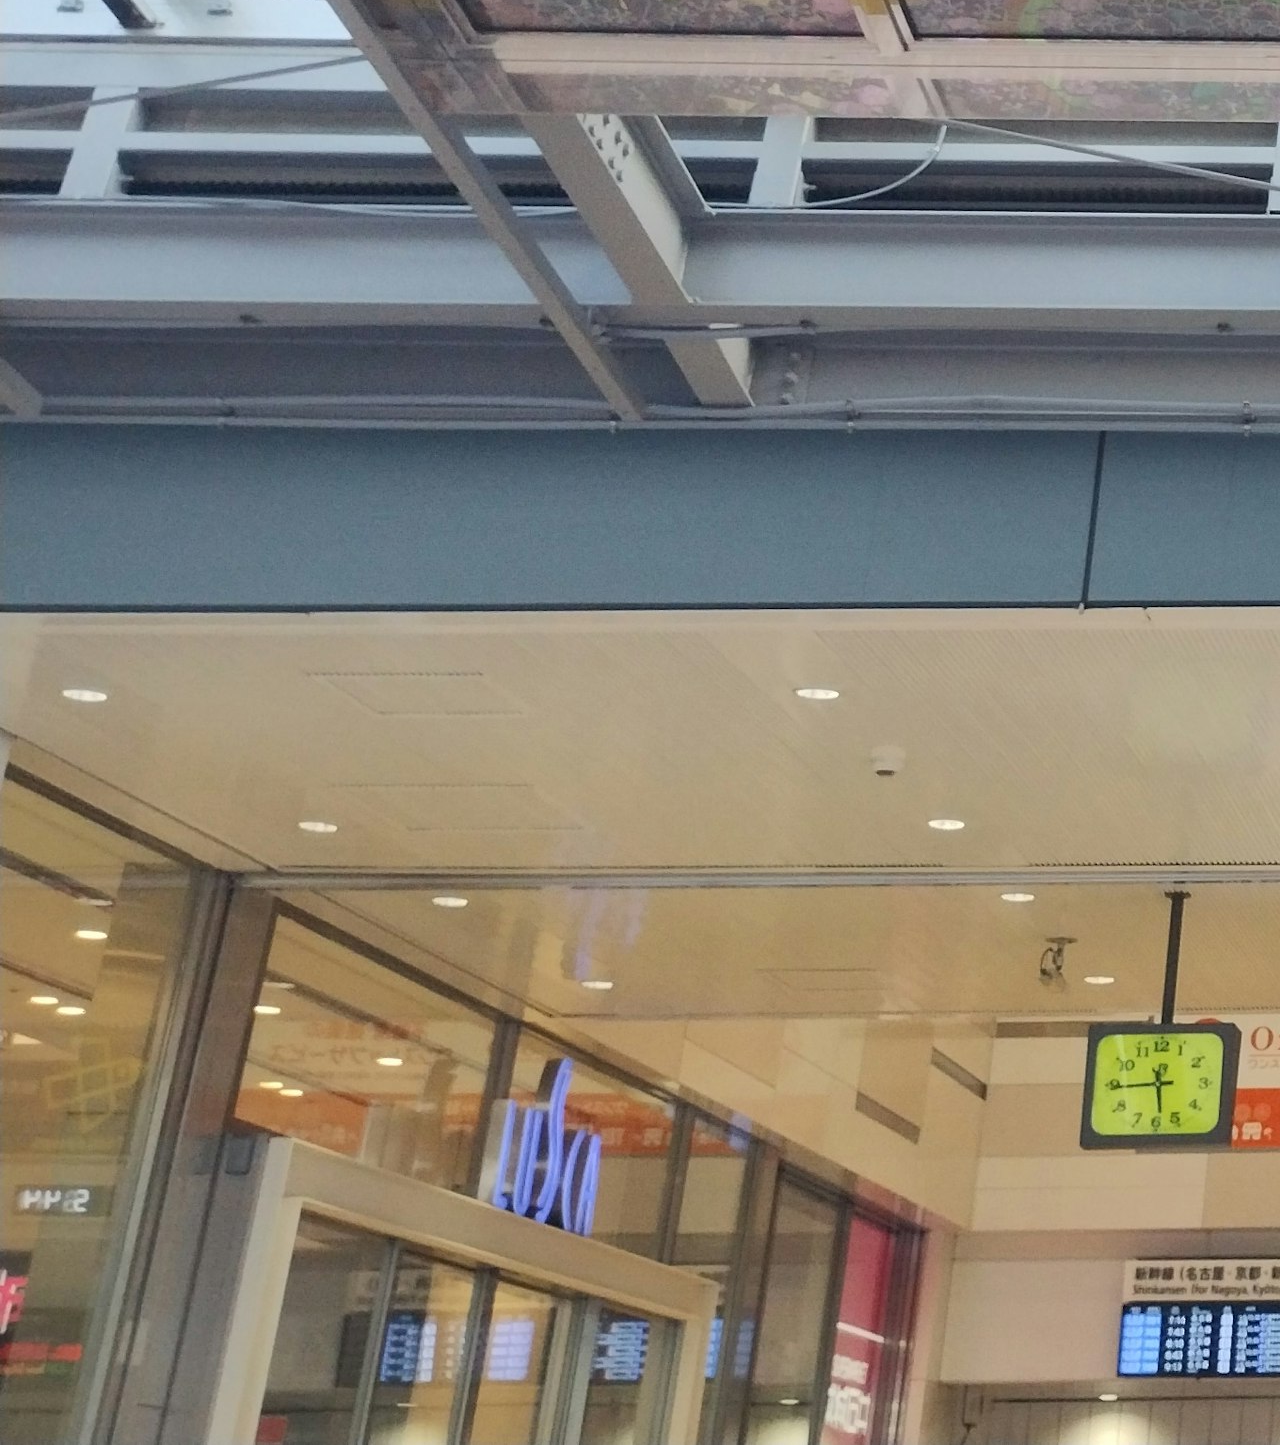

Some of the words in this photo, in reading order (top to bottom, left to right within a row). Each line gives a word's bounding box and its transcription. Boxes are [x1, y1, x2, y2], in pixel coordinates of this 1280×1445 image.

[1136, 1045, 1149, 1058] 11
[1154, 1040, 1170, 1053] 12
[1120, 1060, 1135, 1071] 10
[1191, 1057, 1202, 1068] 2
[1199, 1078, 1209, 1089] 3
[1116, 1101, 1126, 1112] 8
[1187, 1098, 1198, 1110] 4
[1132, 1114, 1142, 1127] 7
[1151, 1115, 1161, 1128] 6
[1170, 1112, 1180, 1124] 5
